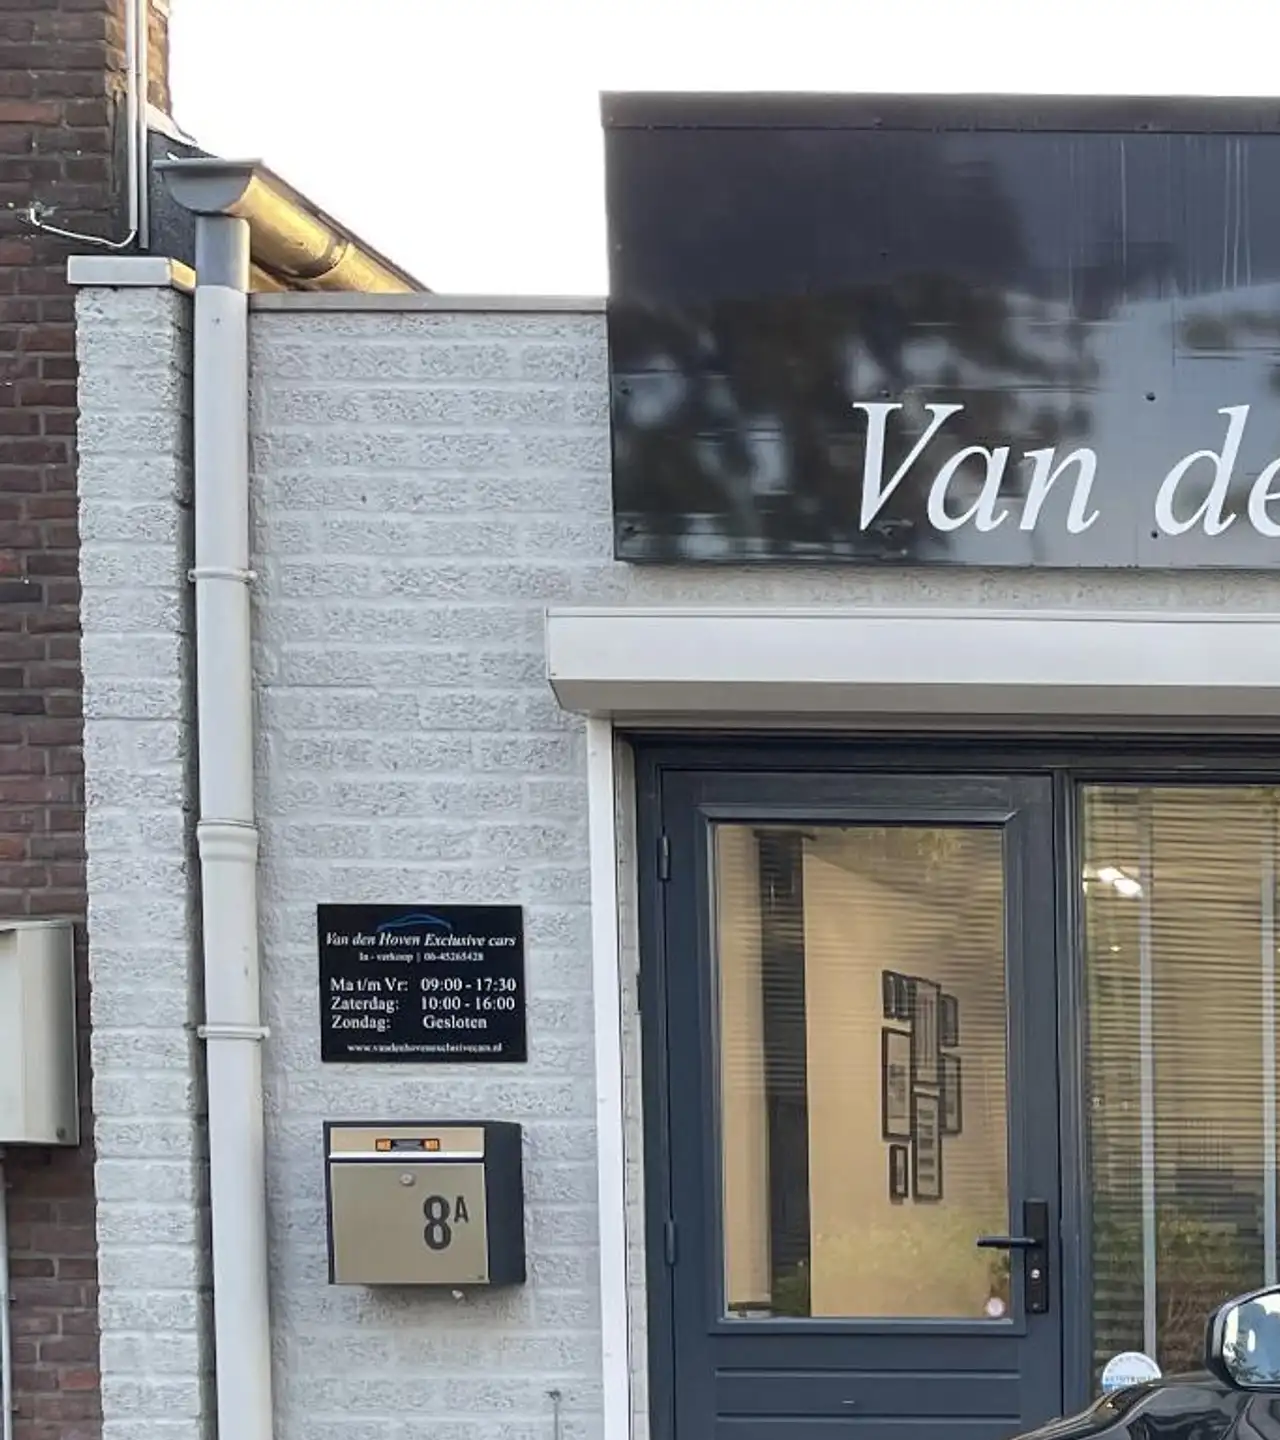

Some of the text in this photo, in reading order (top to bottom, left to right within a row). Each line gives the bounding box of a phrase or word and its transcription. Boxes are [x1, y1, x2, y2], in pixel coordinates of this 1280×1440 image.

[852, 400, 1100, 533] Van
[326, 931, 516, 948] Van den Hoven Exclusive cars
[329, 977, 356, 992] Ma
[357, 977, 382, 992] t/m
[384, 977, 409, 992] Vr:
[420, 977, 463, 992] 09:00
[475, 977, 517, 992] 17:30
[330, 996, 399, 1013] Zaterdag:
[421, 996, 461, 1011] 10:00
[475, 996, 516, 1011] 16:00
[331, 1014, 488, 1032] Zondag: Gesloten
